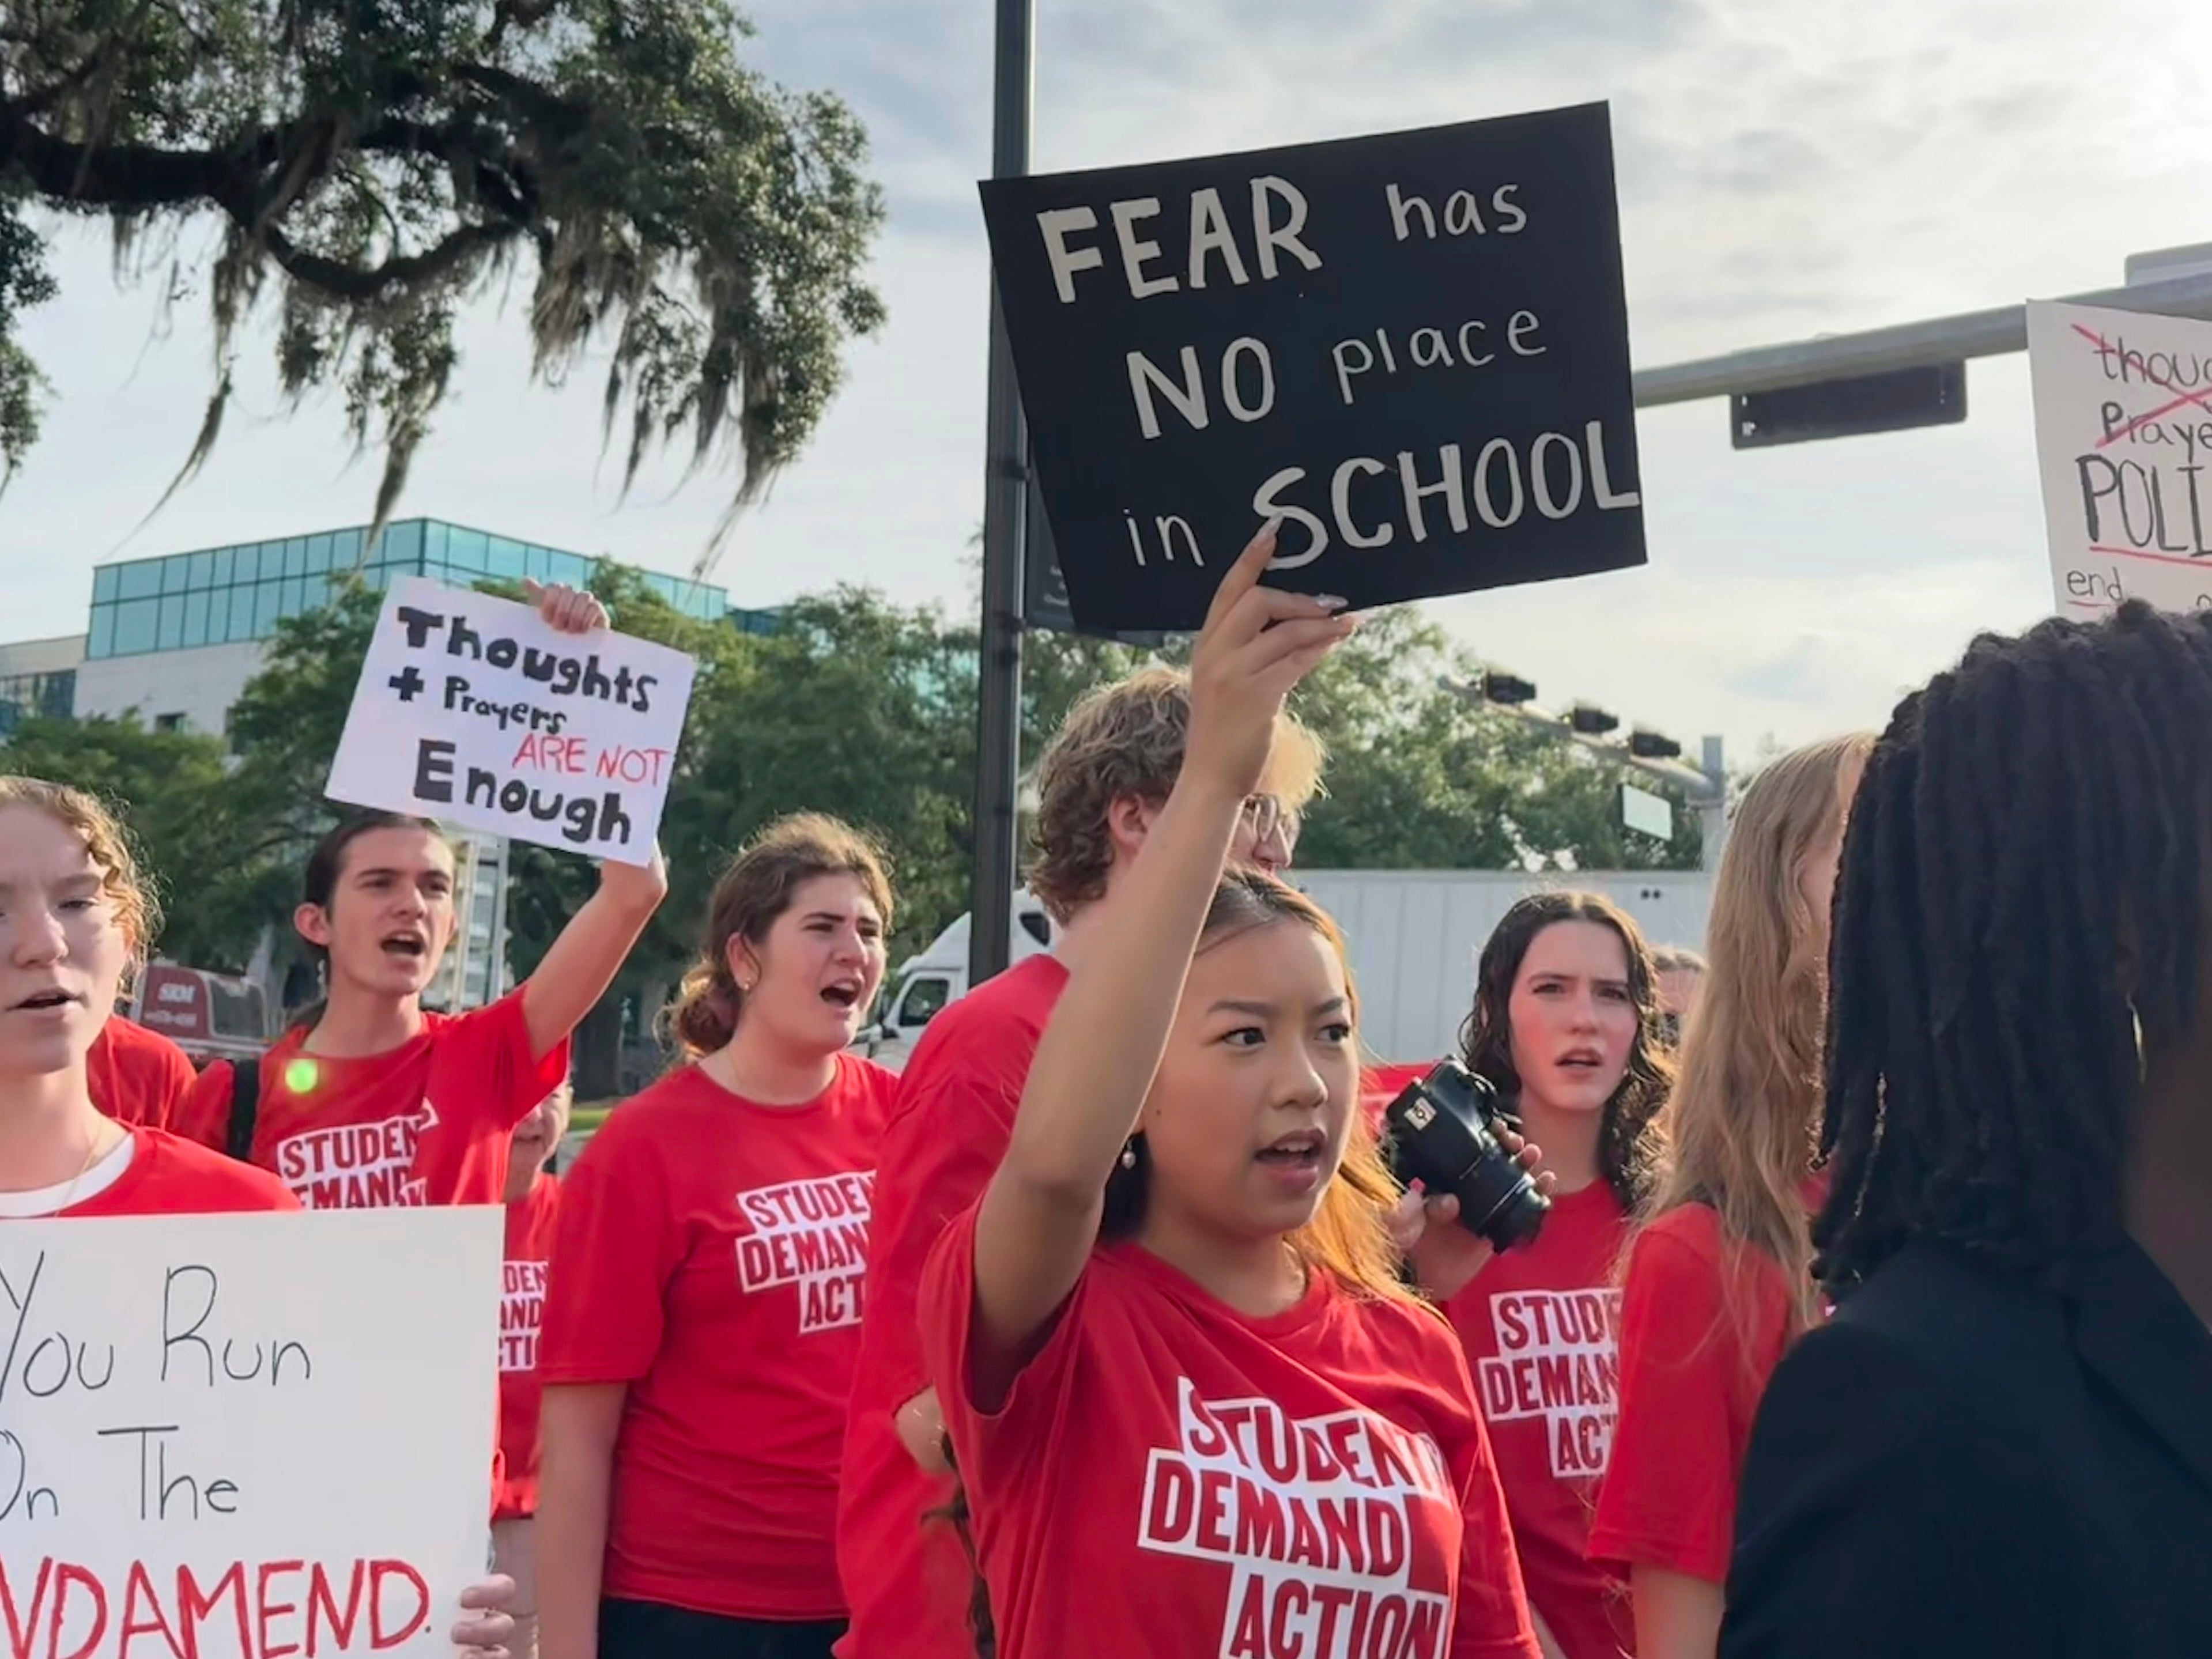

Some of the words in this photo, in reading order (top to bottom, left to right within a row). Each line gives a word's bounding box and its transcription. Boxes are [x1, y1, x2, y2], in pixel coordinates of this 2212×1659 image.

[1037, 176, 1322, 304] FEAR
[1386, 183, 1527, 240] has
[1126, 337, 1275, 439] NO
[1333, 310, 1547, 404] place
[1123, 509, 1205, 566] in
[1253, 421, 1640, 570] SCHOOL
[2067, 566, 2123, 601] end
[388, 666, 425, 702] +
[444, 676, 567, 735] Prayers
[398, 606, 658, 713] Thoughts
[413, 738, 632, 845] Enough
[512, 732, 587, 773] ARE
[596, 746, 667, 787] NOT
[742, 1222, 869, 1287] DEMAN
[805, 1274, 863, 1328] ACT
[0, 1250, 114, 1403] You
[161, 1265, 311, 1386] Run
[1484, 1352, 1618, 1414] DEMAN
[97, 1426, 239, 1521] The
[1147, 1457, 1406, 1577] DEMAND
[1229, 1574, 1443, 1659] ACTION
